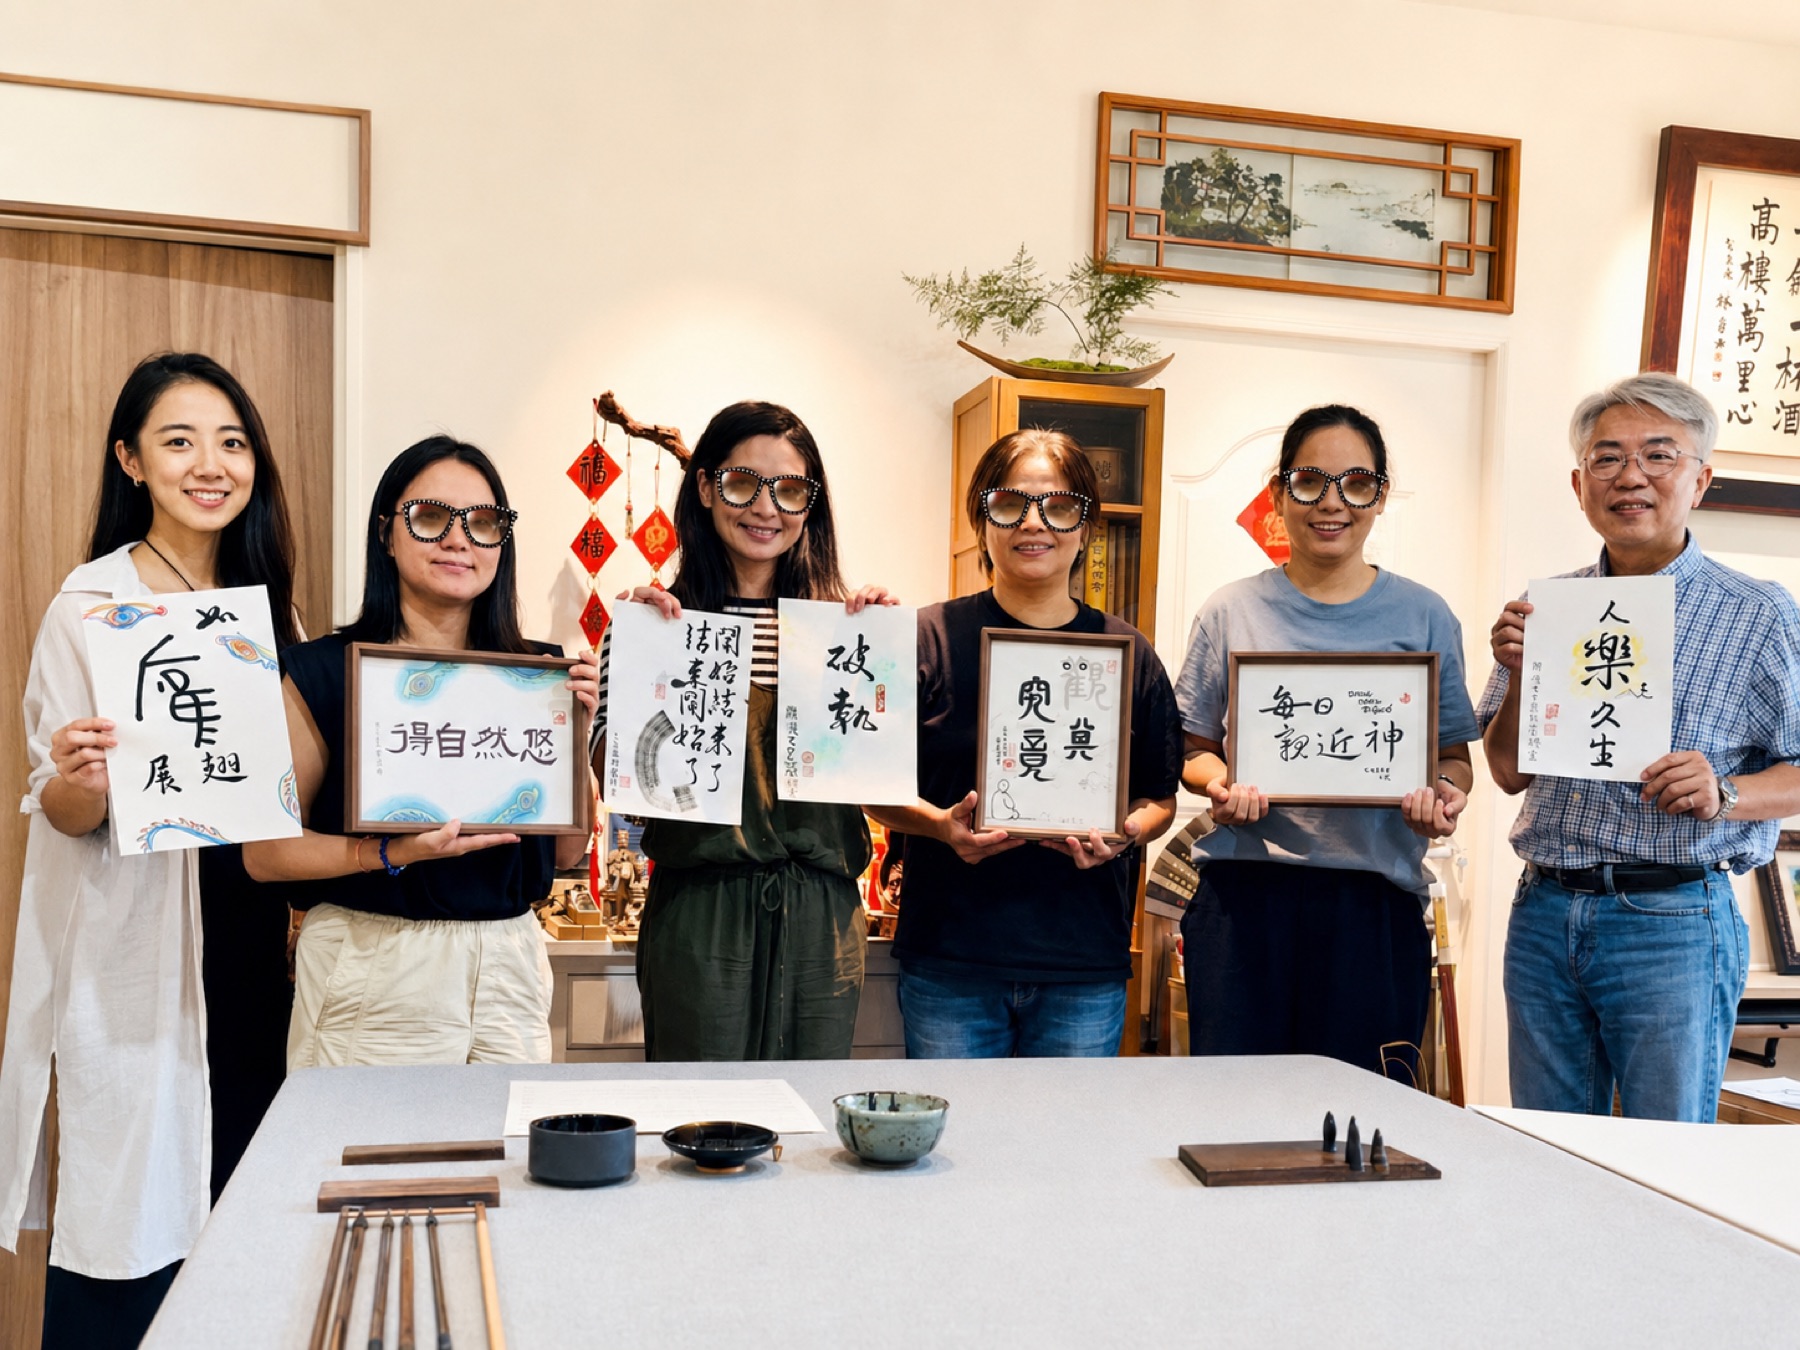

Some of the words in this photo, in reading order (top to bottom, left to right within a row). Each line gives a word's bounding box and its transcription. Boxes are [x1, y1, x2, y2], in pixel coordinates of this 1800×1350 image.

[1727, 198, 1780, 425] 高樓萬里心
[578, 453, 607, 490] 福
[580, 529, 605, 559] 福
[1259, 685, 1334, 720] 每日
